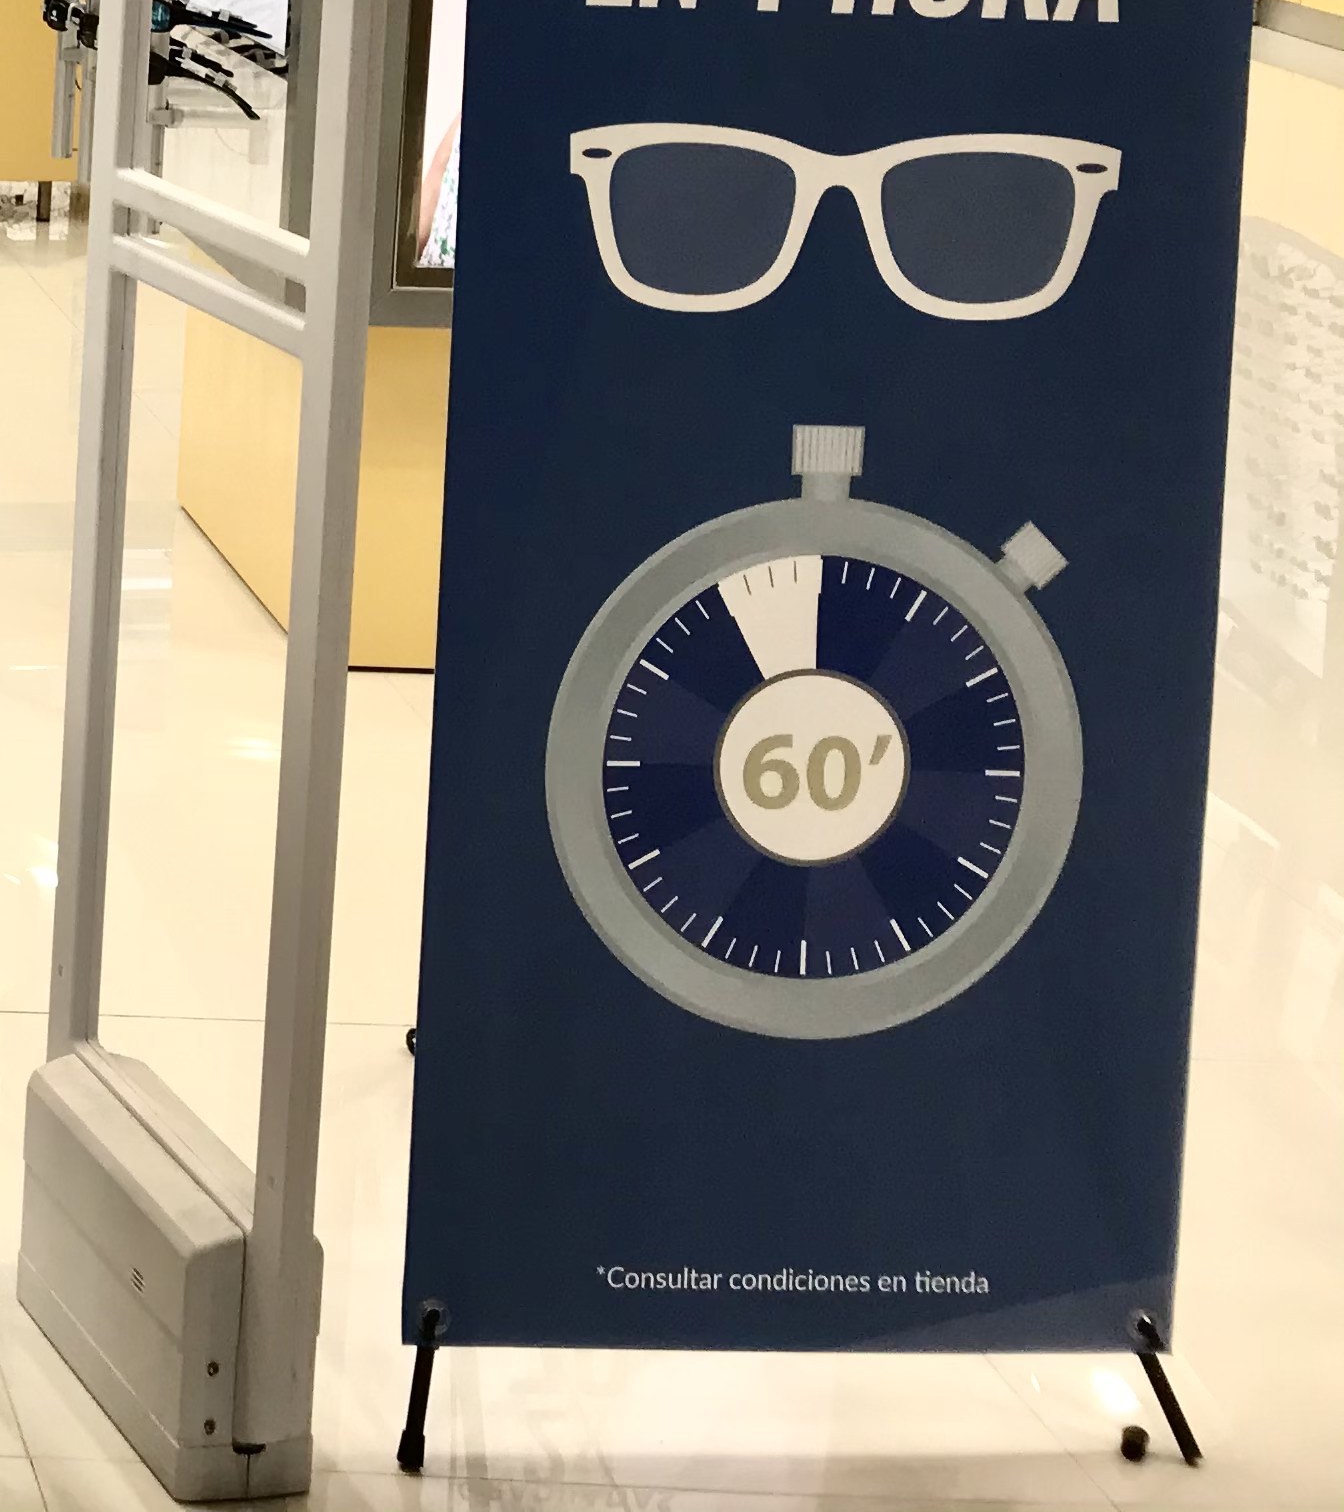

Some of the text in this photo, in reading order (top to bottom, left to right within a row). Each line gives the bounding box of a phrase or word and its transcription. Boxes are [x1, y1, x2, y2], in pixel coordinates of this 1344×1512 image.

[728, 1267, 871, 1293] condiciones
[877, 1274, 907, 1293] en
[915, 1268, 990, 1294] tienda
